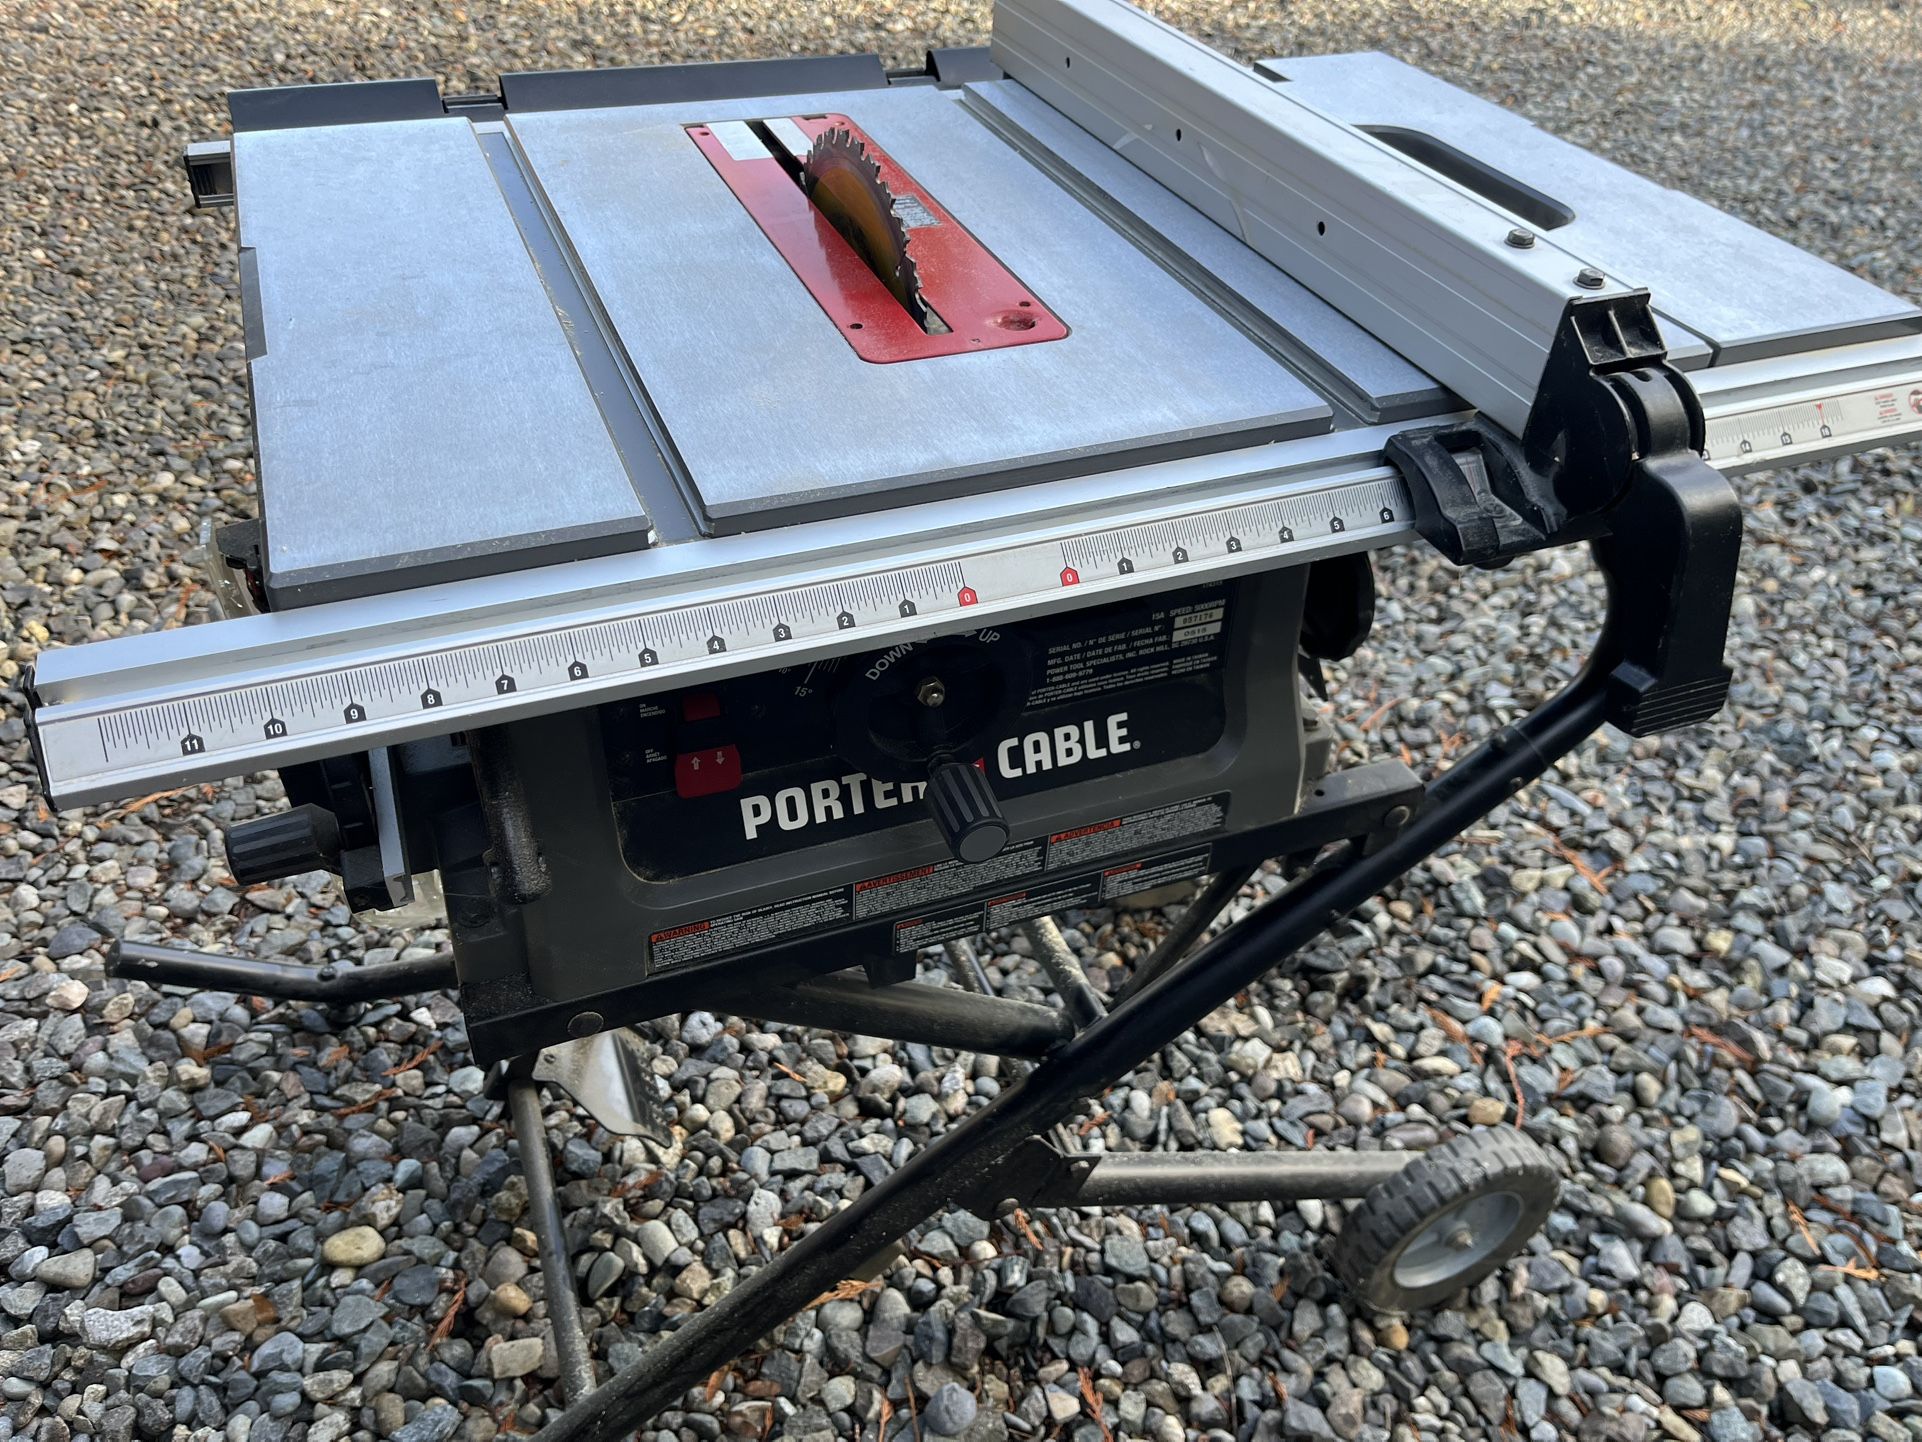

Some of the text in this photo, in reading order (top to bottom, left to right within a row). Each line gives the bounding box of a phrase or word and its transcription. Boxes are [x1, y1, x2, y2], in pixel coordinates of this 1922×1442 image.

[1741, 442, 1750, 452] 14
[1782, 434, 1791, 444] 15
[1066, 511, 1390, 582] 0 1 2 3 4 5 6
[978, 628, 1001, 644] UP
[1048, 644, 1070, 655] SERIAL
[1071, 641, 1083, 650] NO.
[1097, 636, 1107, 644] DE
[1131, 626, 1153, 637] SERIAL
[1064, 653, 1081, 663] DATE
[1086, 649, 1103, 658] DATE
[1104, 646, 1113, 654] DE
[1133, 637, 1154, 648] FECHA
[184, 592, 971, 752] 11 10 9 8 7 6 5 4 3 2 1 0
[865, 642, 914, 681] DOWN
[1046, 665, 1069, 676] POWER
[1069, 662, 1084, 671] TOOL
[1138, 646, 1155, 656] ROCK
[997, 712, 1132, 780] CABLE
[663, 922, 706, 939] WARNING
